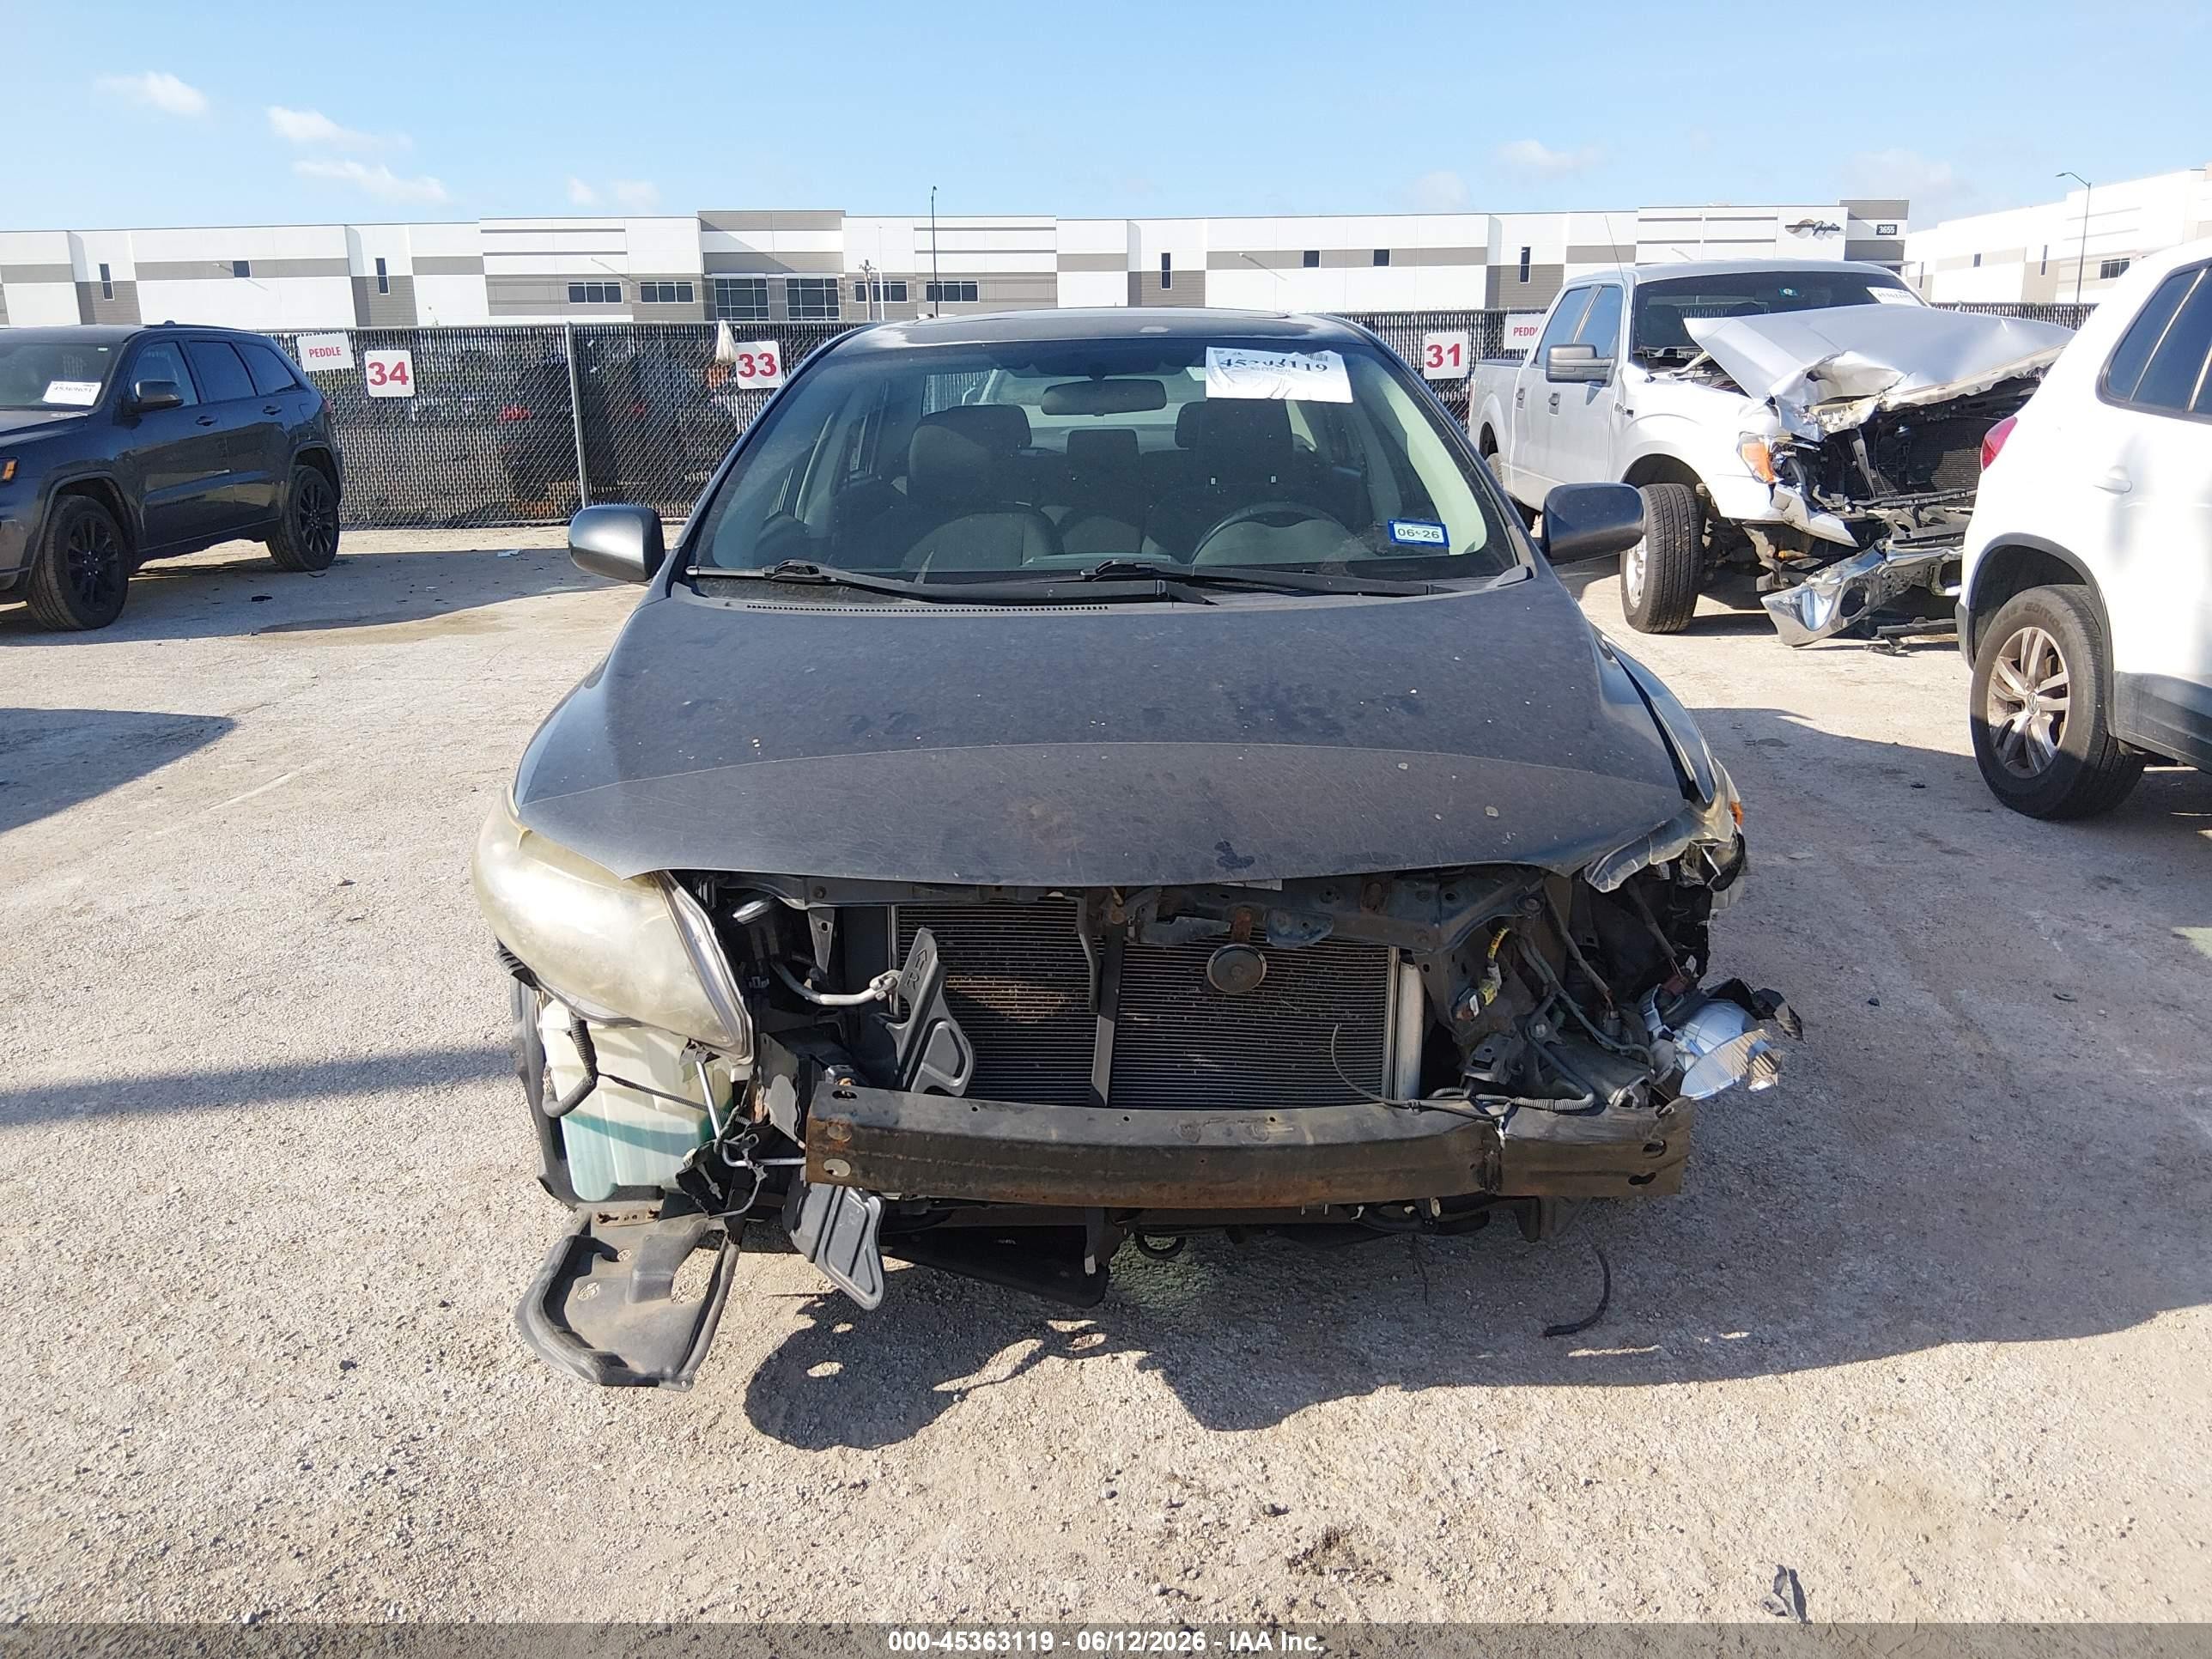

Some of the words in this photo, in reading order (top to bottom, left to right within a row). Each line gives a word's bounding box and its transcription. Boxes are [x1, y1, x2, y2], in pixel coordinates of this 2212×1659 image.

[308, 346, 342, 358] PEDDLE
[1426, 343, 1462, 369] 31
[369, 362, 409, 386] 34
[738, 352, 777, 378] 33
